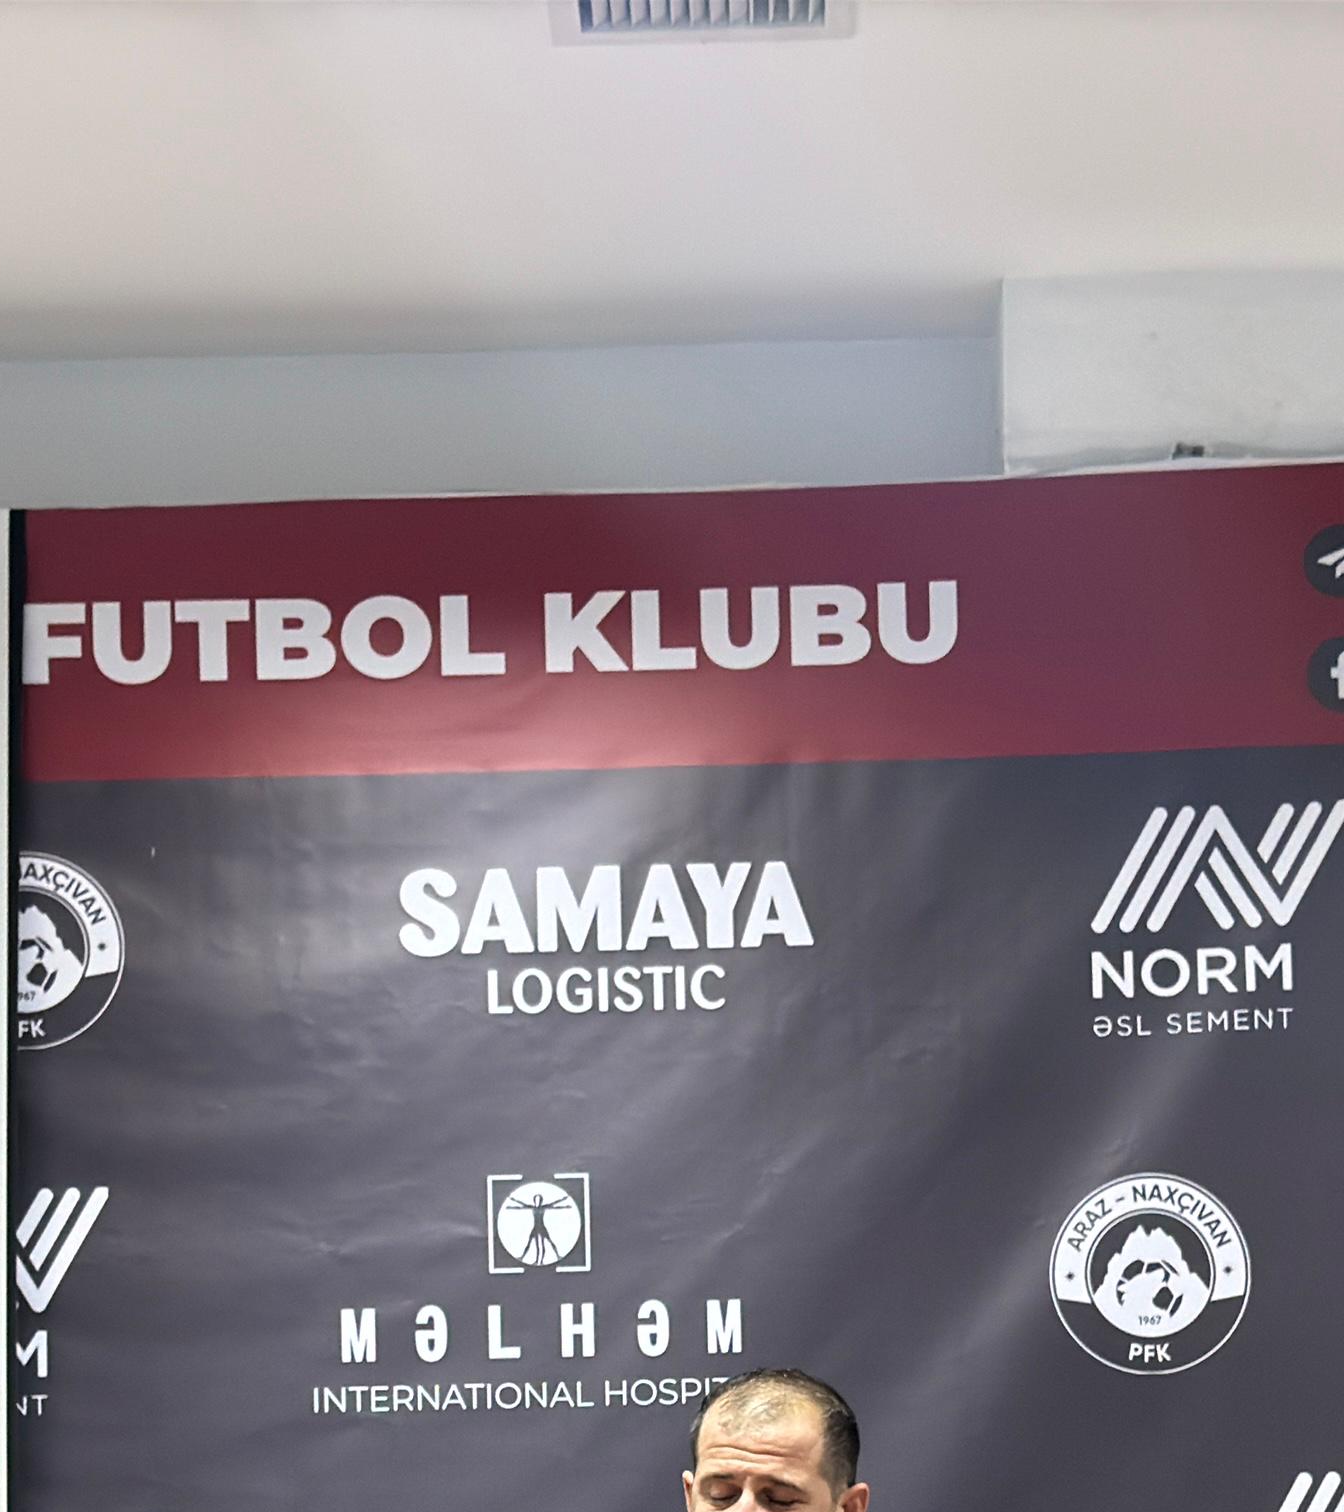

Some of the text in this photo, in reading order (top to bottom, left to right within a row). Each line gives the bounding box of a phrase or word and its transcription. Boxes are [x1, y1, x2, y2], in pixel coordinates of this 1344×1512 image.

[22, 580, 958, 685] FUTBOL KLUBU
[20, 861, 108, 926] AXÇIVAN
[398, 860, 814, 958] SAMAYA
[487, 964, 726, 1014] LOGISTIC
[1091, 942, 1293, 999] NORM
[1166, 1007, 1293, 1035] SEMENT
[1128, 1342, 1171, 1363] PFK
[313, 1380, 595, 1414] INTERNATIONAL
